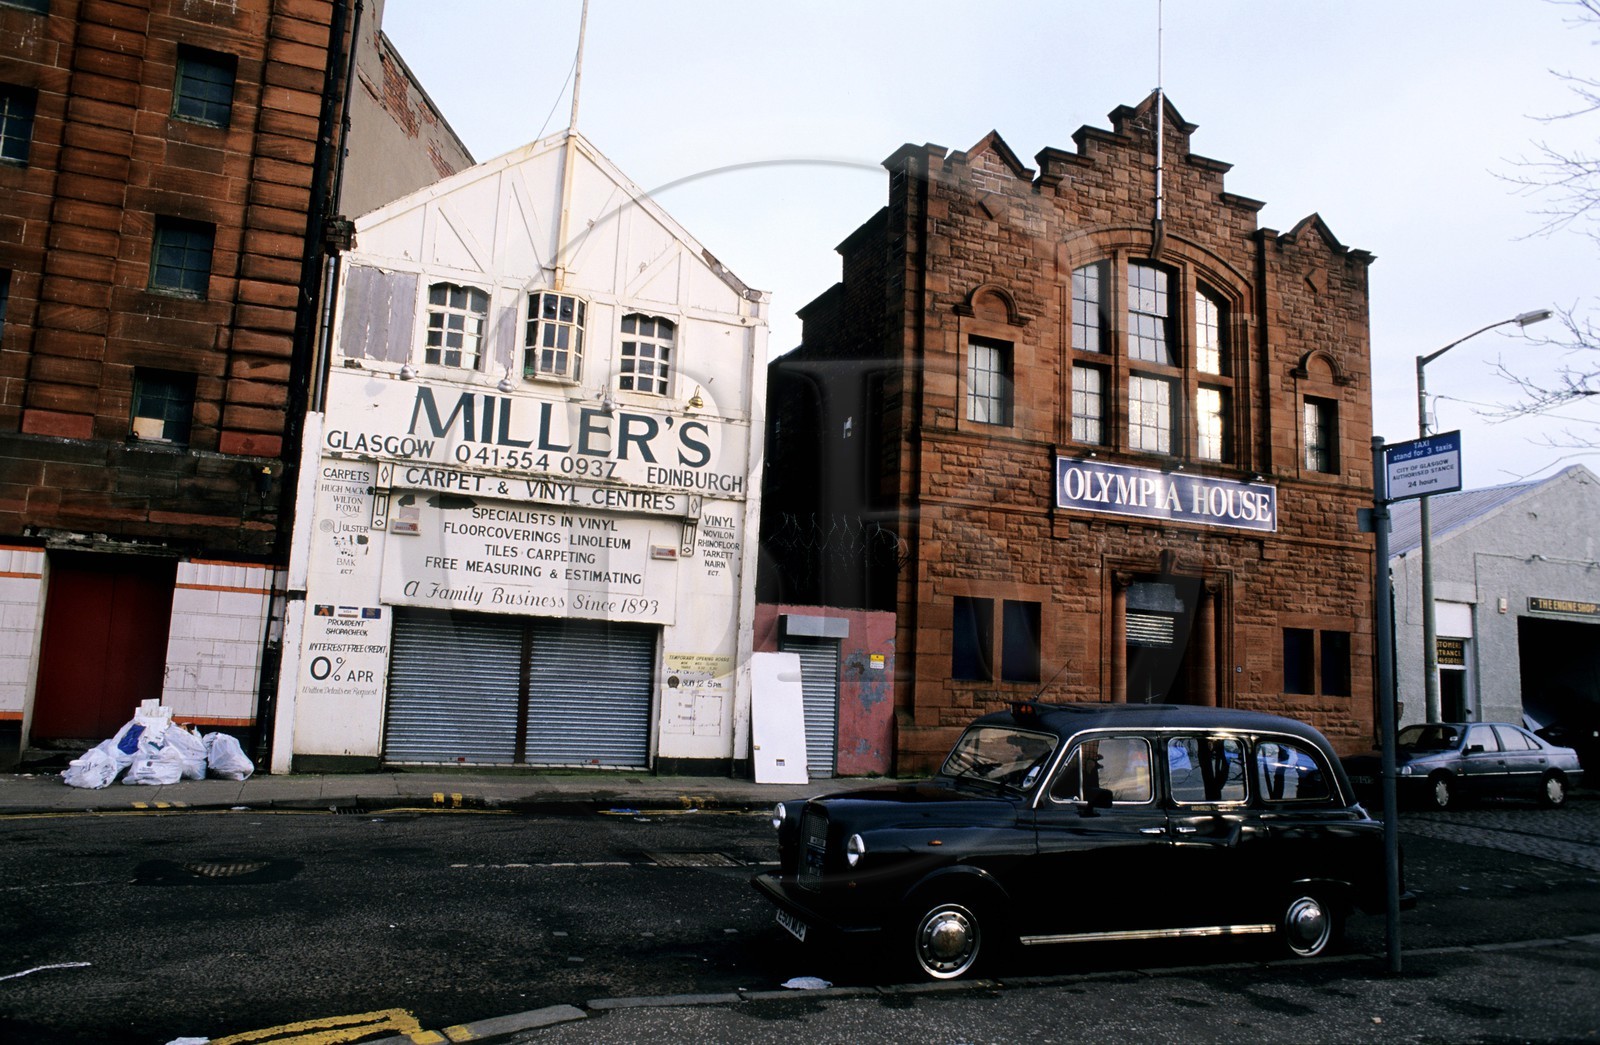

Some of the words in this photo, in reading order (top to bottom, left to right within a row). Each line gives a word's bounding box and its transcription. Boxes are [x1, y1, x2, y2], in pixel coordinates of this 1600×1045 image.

[407, 385, 712, 469] MILLER'S
[327, 430, 435, 458] GLASGOW
[1414, 441, 1430, 449] TAXI
[1394, 452, 1412, 461] stand
[1435, 444, 1453, 452] taxis
[561, 456, 617, 479] 0937
[1419, 459, 1449, 469] GLASGOW
[323, 468, 370, 481] CARPETS
[1392, 470, 1430, 480] AUTHORISED
[1431, 464, 1454, 473] STANCE
[647, 466, 743, 493] EDINBURGH
[1419, 478, 1438, 486] hours
[321, 484, 343, 494] HUGH
[406, 468, 486, 492] CARPET
[497, 481, 509, 495] &
[527, 480, 580, 503] VINYL
[591, 488, 676, 511] CENTRES
[1063, 467, 1182, 512] OLYMPIA
[1192, 484, 1272, 522] HOUSE
[333, 495, 363, 505] WILTON
[336, 503, 361, 513] ROYAL
[472, 507, 556, 527] SPECIALISTS
[561, 512, 573, 527] IN
[578, 517, 618, 532] VINYL
[704, 514, 735, 528] VINYL
[342, 524, 369, 533] ULSTER
[703, 530, 734, 540] NOVILON
[443, 522, 561, 544] FLOORCOVERINGS
[569, 534, 631, 550] LINOLEUM
[698, 539, 740, 550] RHINOFLOOR
[484, 544, 518, 558] TILES
[526, 548, 596, 565] CARPETING
[703, 550, 733, 559] TARKETT
[336, 558, 356, 567] BMK
[704, 560, 726, 568] NAIRN
[425, 556, 458, 571] FREE
[465, 560, 542, 578] MEASURING
[549, 569, 558, 579] &
[565, 569, 642, 585] ESTIMATING
[404, 580, 420, 598] A
[426, 582, 484, 606] Family
[492, 587, 565, 608] Business
[573, 594, 617, 613] Since
[621, 598, 659, 616] 1893
[1539, 599, 1552, 609] THE
[327, 619, 366, 628] PROVIDENT
[309, 642, 346, 652] INTEREST
[346, 644, 364, 653] FREE
[364, 645, 386, 654] CREDIT
[310, 656, 346, 681] 0%
[347, 670, 374, 682] APR
